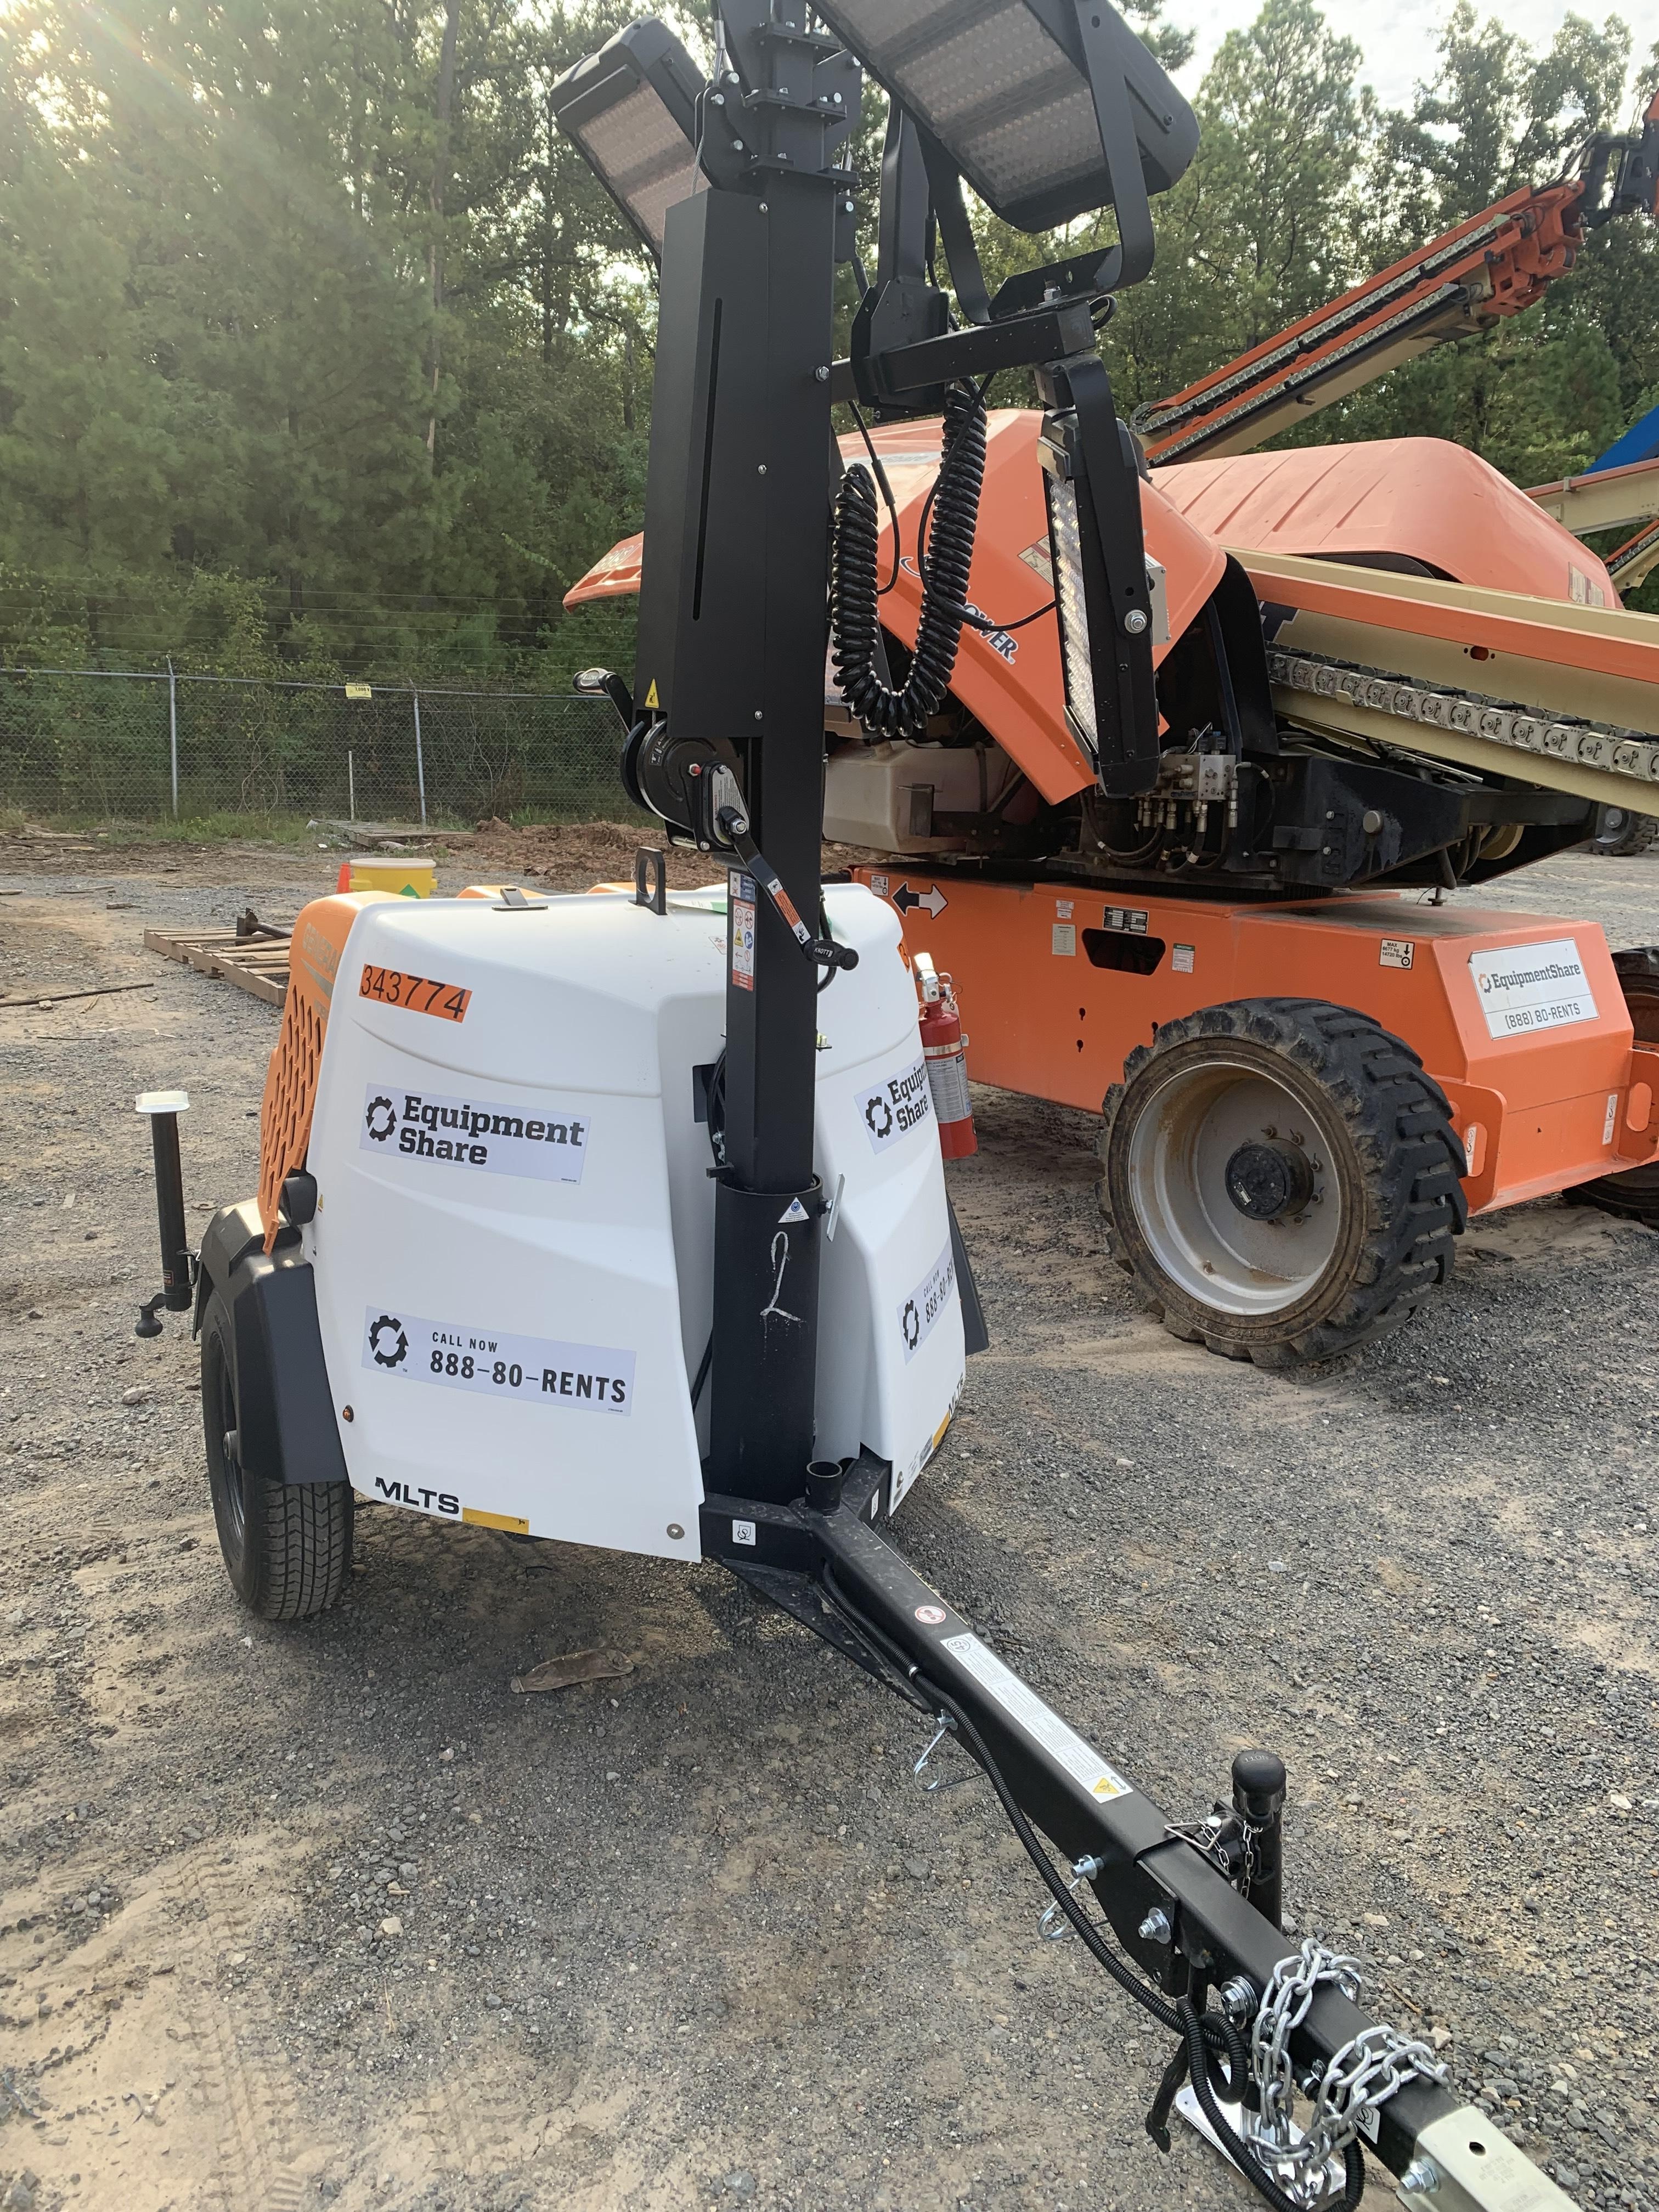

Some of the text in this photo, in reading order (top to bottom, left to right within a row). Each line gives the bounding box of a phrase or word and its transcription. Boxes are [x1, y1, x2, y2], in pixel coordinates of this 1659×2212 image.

[814, 947, 830, 956] KNOTT
[361, 965, 466, 1019] 343774
[1491, 964, 1581, 990] EquipmentShare
[1505, 1002, 1581, 1029] (888) 80-RENTS
[403, 1095, 585, 1147] Equipment
[896, 1094, 928, 1132] Share
[399, 1127, 487, 1165] Share
[923, 1282, 933, 1298] CALL
[432, 1331, 498, 1353] CALL NOW
[430, 1350, 627, 1403] 888-80-RENTS
[375, 1477, 460, 1515] MLTS
